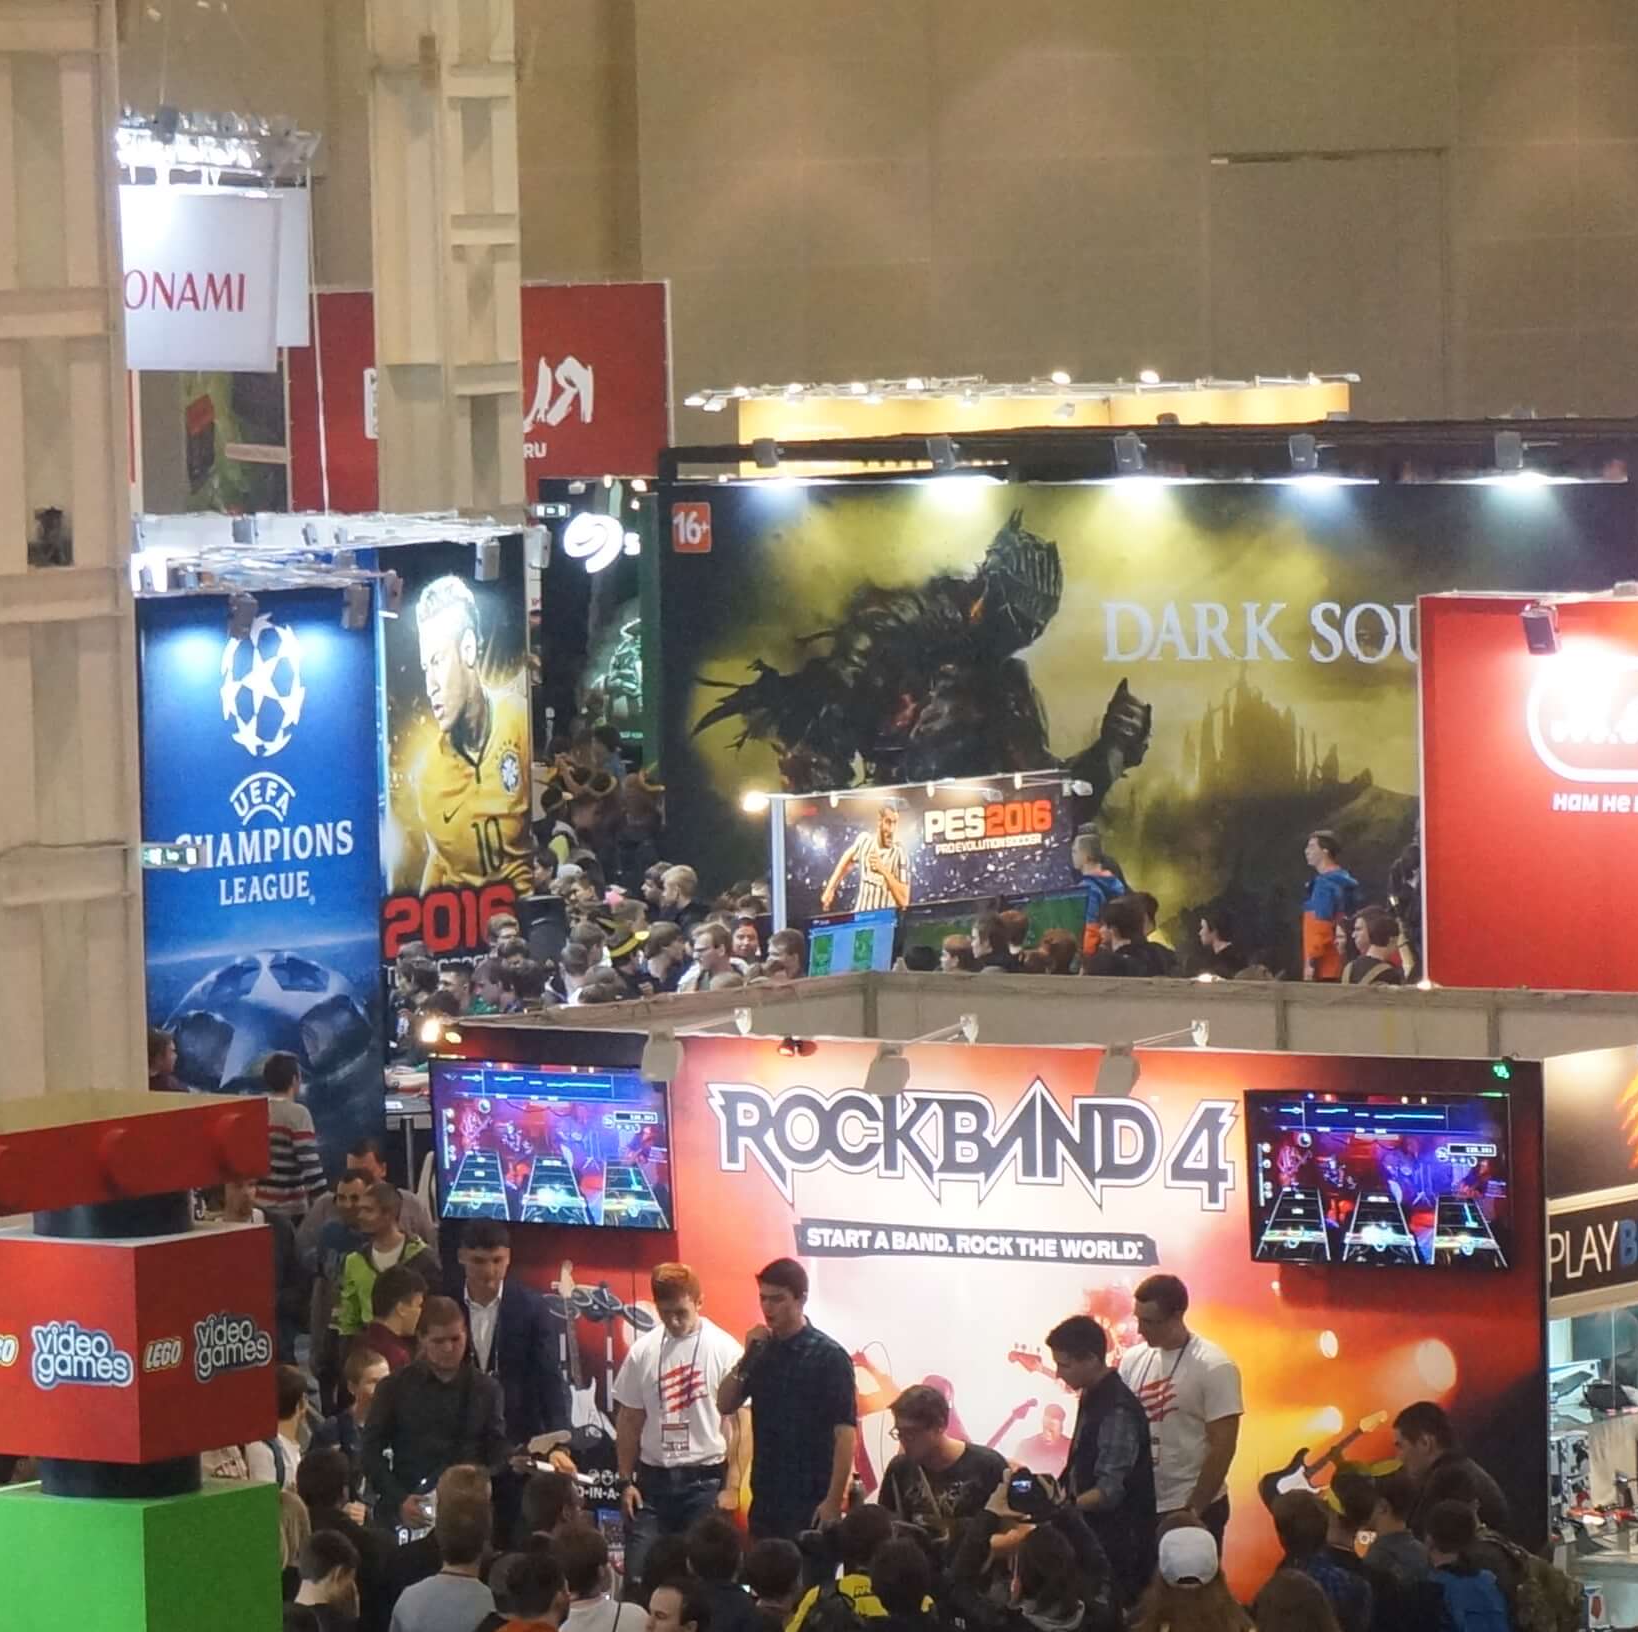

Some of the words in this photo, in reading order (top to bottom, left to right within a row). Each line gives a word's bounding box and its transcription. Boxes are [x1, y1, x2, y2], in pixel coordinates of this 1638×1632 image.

[123, 269, 246, 312] ONAMI
[673, 511, 710, 545] 16+
[1102, 602, 1290, 664] DARK
[233, 778, 290, 817] UEFA
[1552, 792, 1599, 812] нам
[1602, 793, 1631, 814] не
[219, 870, 311, 906] LEAGUE
[1164, 1098, 1239, 1212] 4
[806, 1226, 872, 1250] START
[874, 1229, 890, 1250] A
[891, 1231, 954, 1254] BAND.
[955, 1233, 1014, 1257] ROCK
[1014, 1236, 1060, 1258] THE
[37, 1324, 109, 1358] video
[197, 1316, 254, 1348] video
[37, 1353, 128, 1384] games
[146, 1342, 182, 1370] LEGO
[197, 1335, 269, 1377] games
